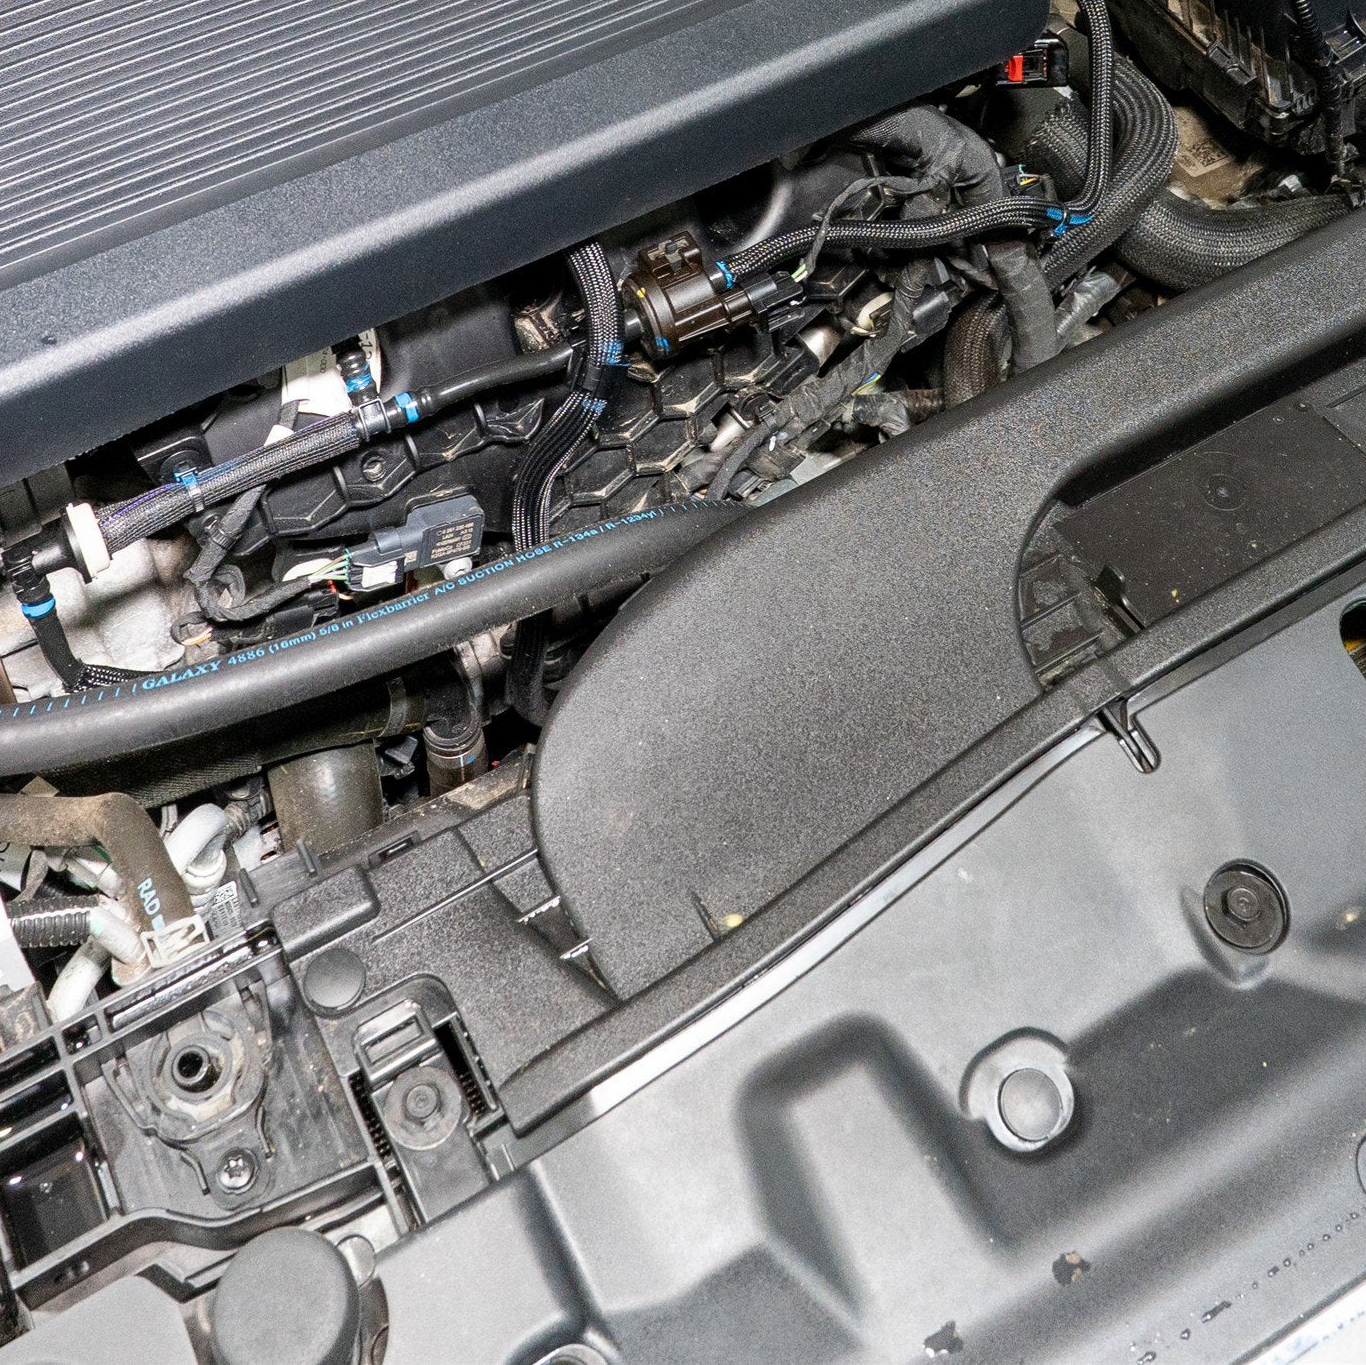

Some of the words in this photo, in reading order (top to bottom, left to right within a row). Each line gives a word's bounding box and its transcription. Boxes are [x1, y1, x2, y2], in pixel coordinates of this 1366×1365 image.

[140, 658, 223, 693] GALAXY
[225, 645, 266, 669] 4886
[340, 616, 355, 629] in
[355, 591, 431, 624] Flexbarrier
[432, 578, 457, 599] A/C
[455, 556, 516, 590] SUCTION
[514, 544, 553, 568] HOSE
[551, 523, 600, 552] R-134a
[137, 877, 162, 916] RAD
